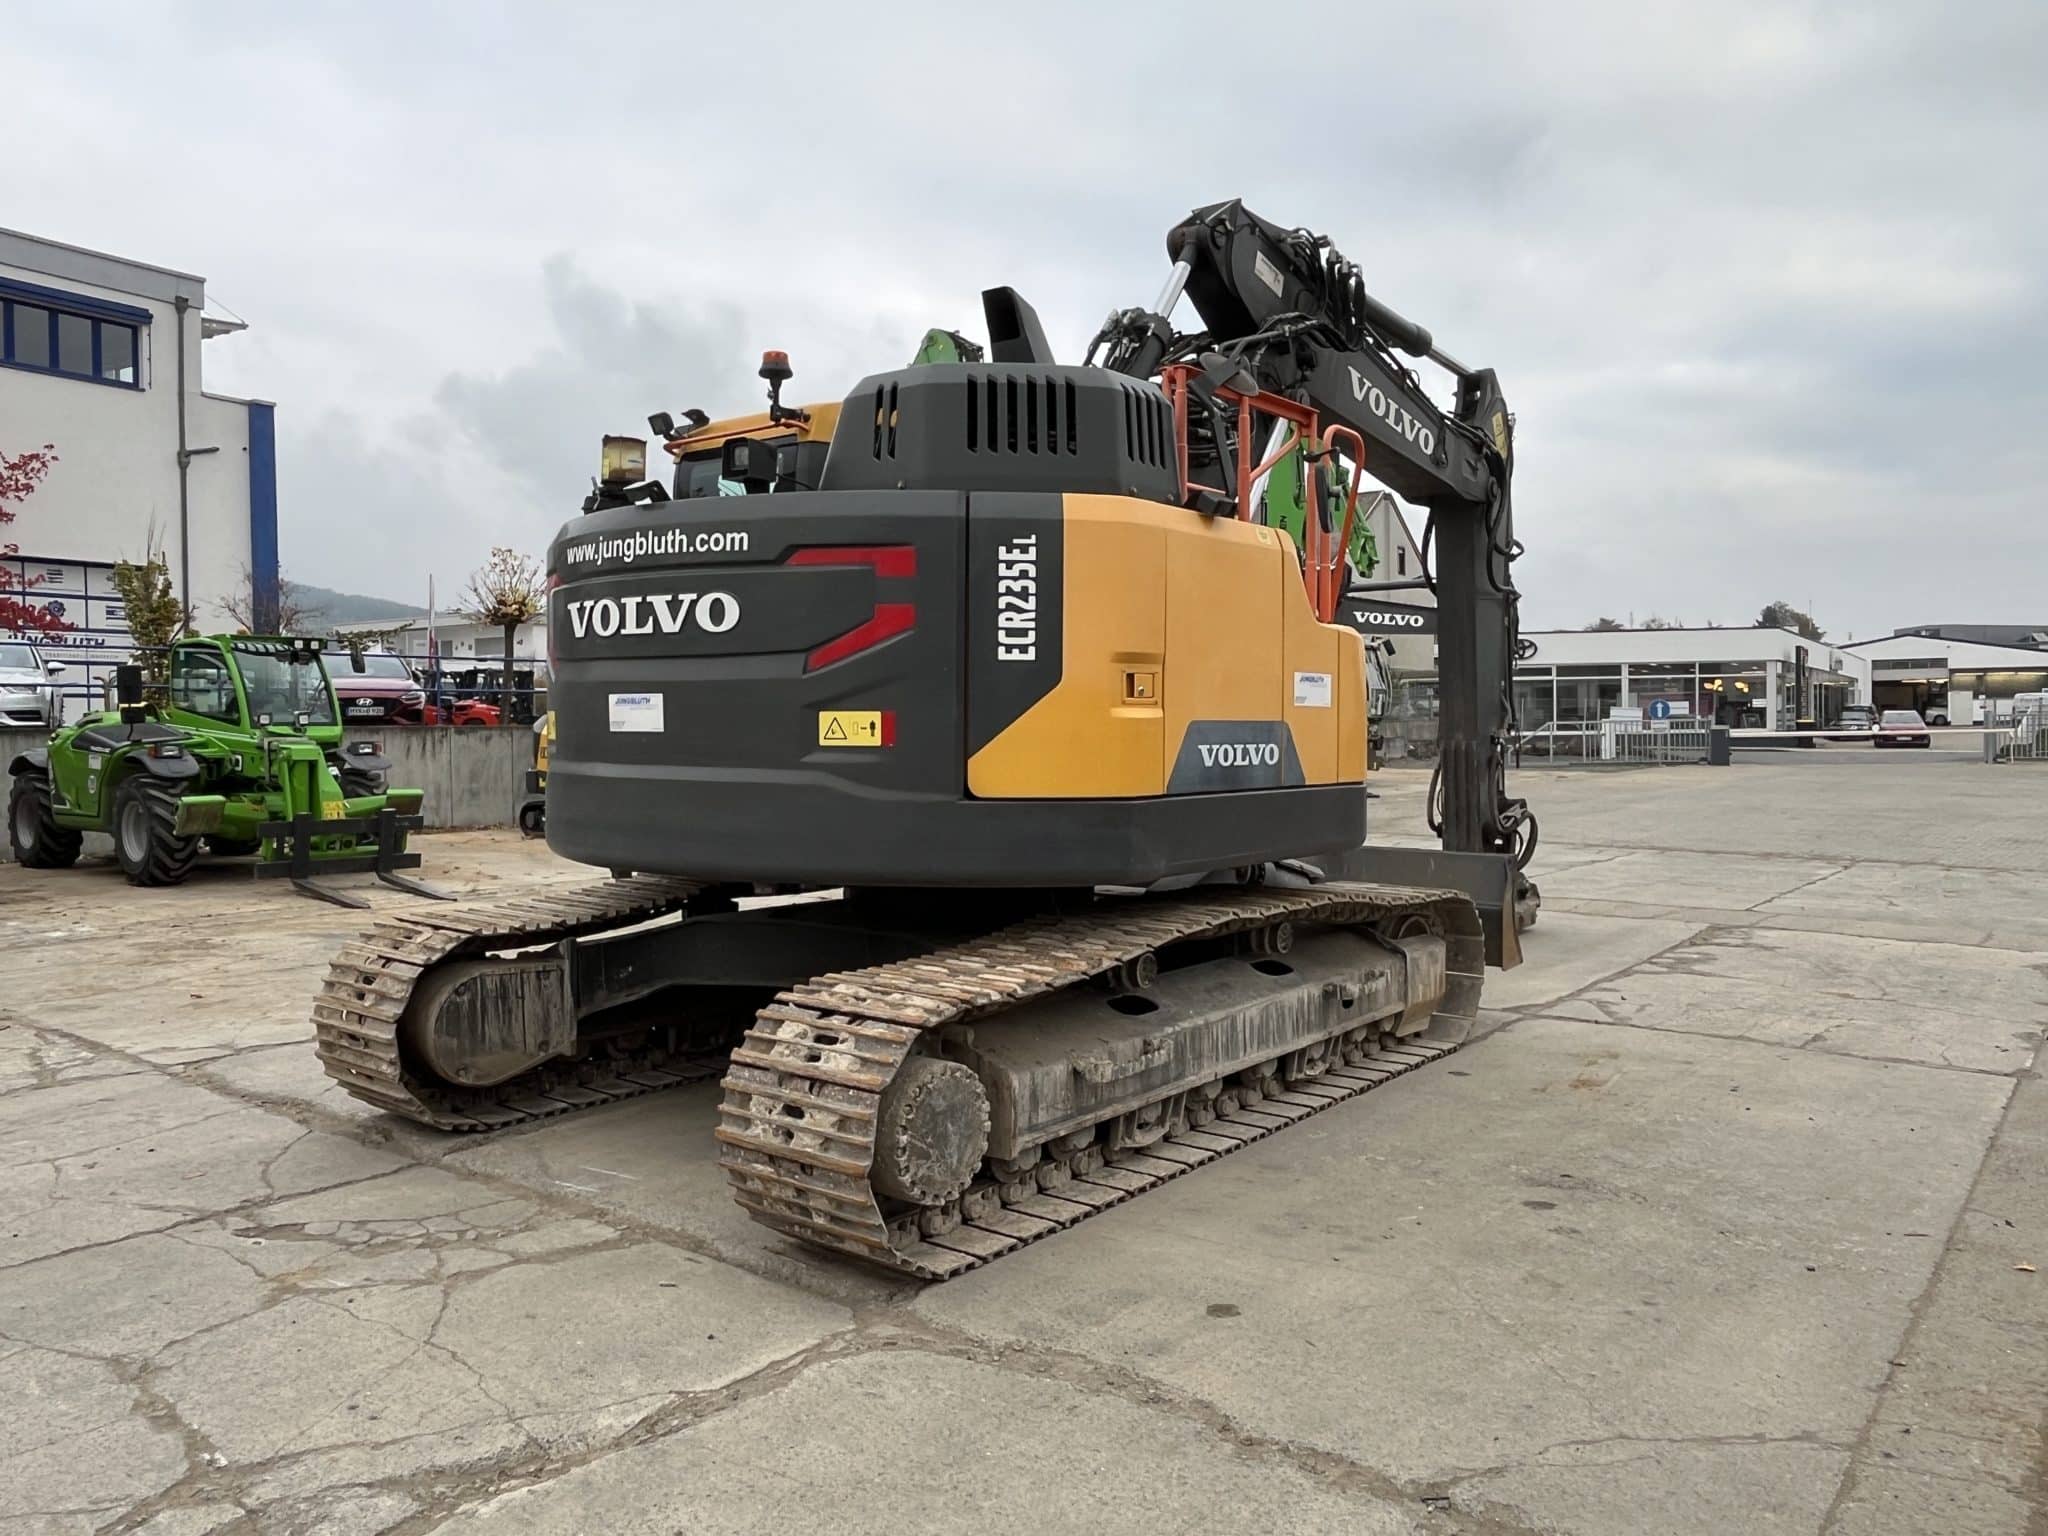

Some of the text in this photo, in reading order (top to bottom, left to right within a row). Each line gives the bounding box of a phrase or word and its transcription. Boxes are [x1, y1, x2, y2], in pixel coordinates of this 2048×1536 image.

[1347, 365, 1434, 455] VOLVO
[567, 529, 749, 565] www.jungbluth.com
[567, 592, 740, 638] VOLVO
[998, 534, 1036, 660] ECR235EL
[1353, 611, 1424, 627] VOLVO
[1198, 744, 1279, 767] VOLVO
